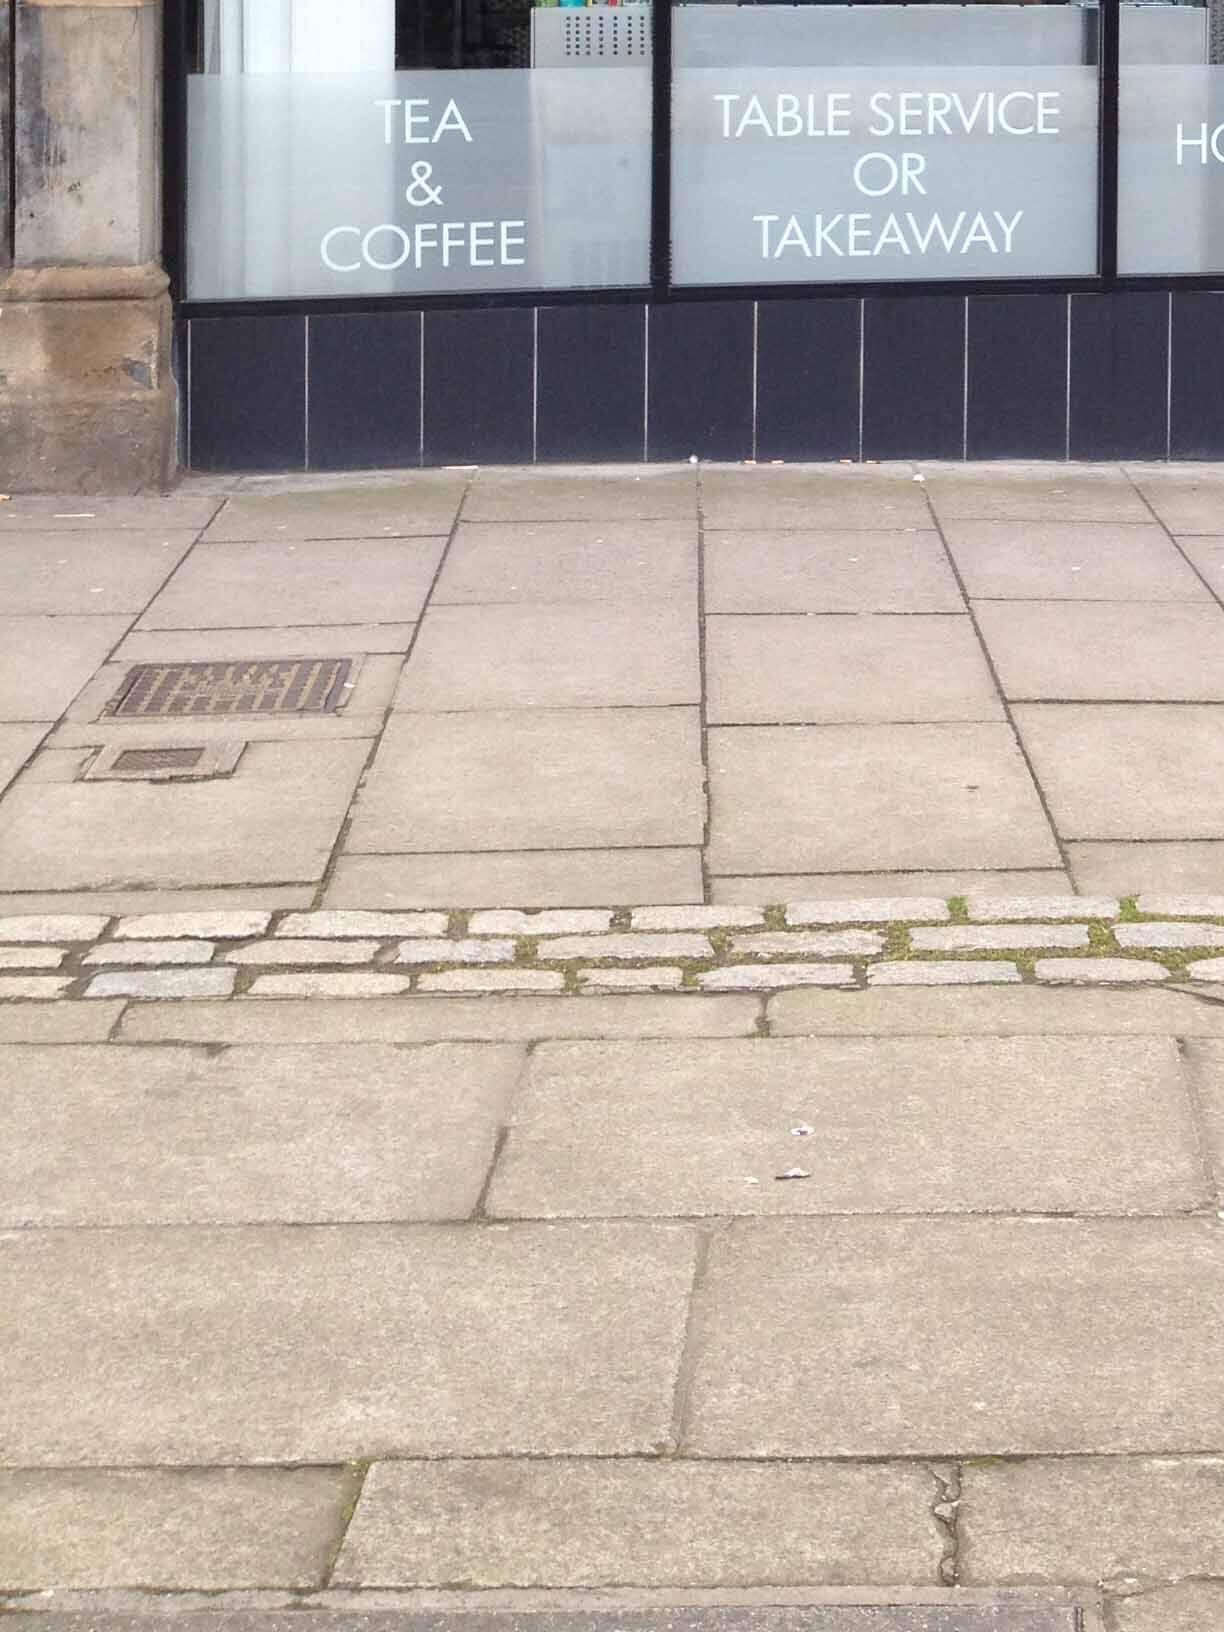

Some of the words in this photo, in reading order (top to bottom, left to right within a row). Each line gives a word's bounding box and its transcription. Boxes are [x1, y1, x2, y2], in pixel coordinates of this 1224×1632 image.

[374, 98, 473, 144] TEA
[714, 93, 852, 138] TABLE
[868, 90, 1061, 136] SERVICE
[405, 160, 445, 208] &
[853, 151, 928, 197] OR
[319, 219, 526, 273] COFFEE
[752, 210, 1024, 260] TAKEAWAY
